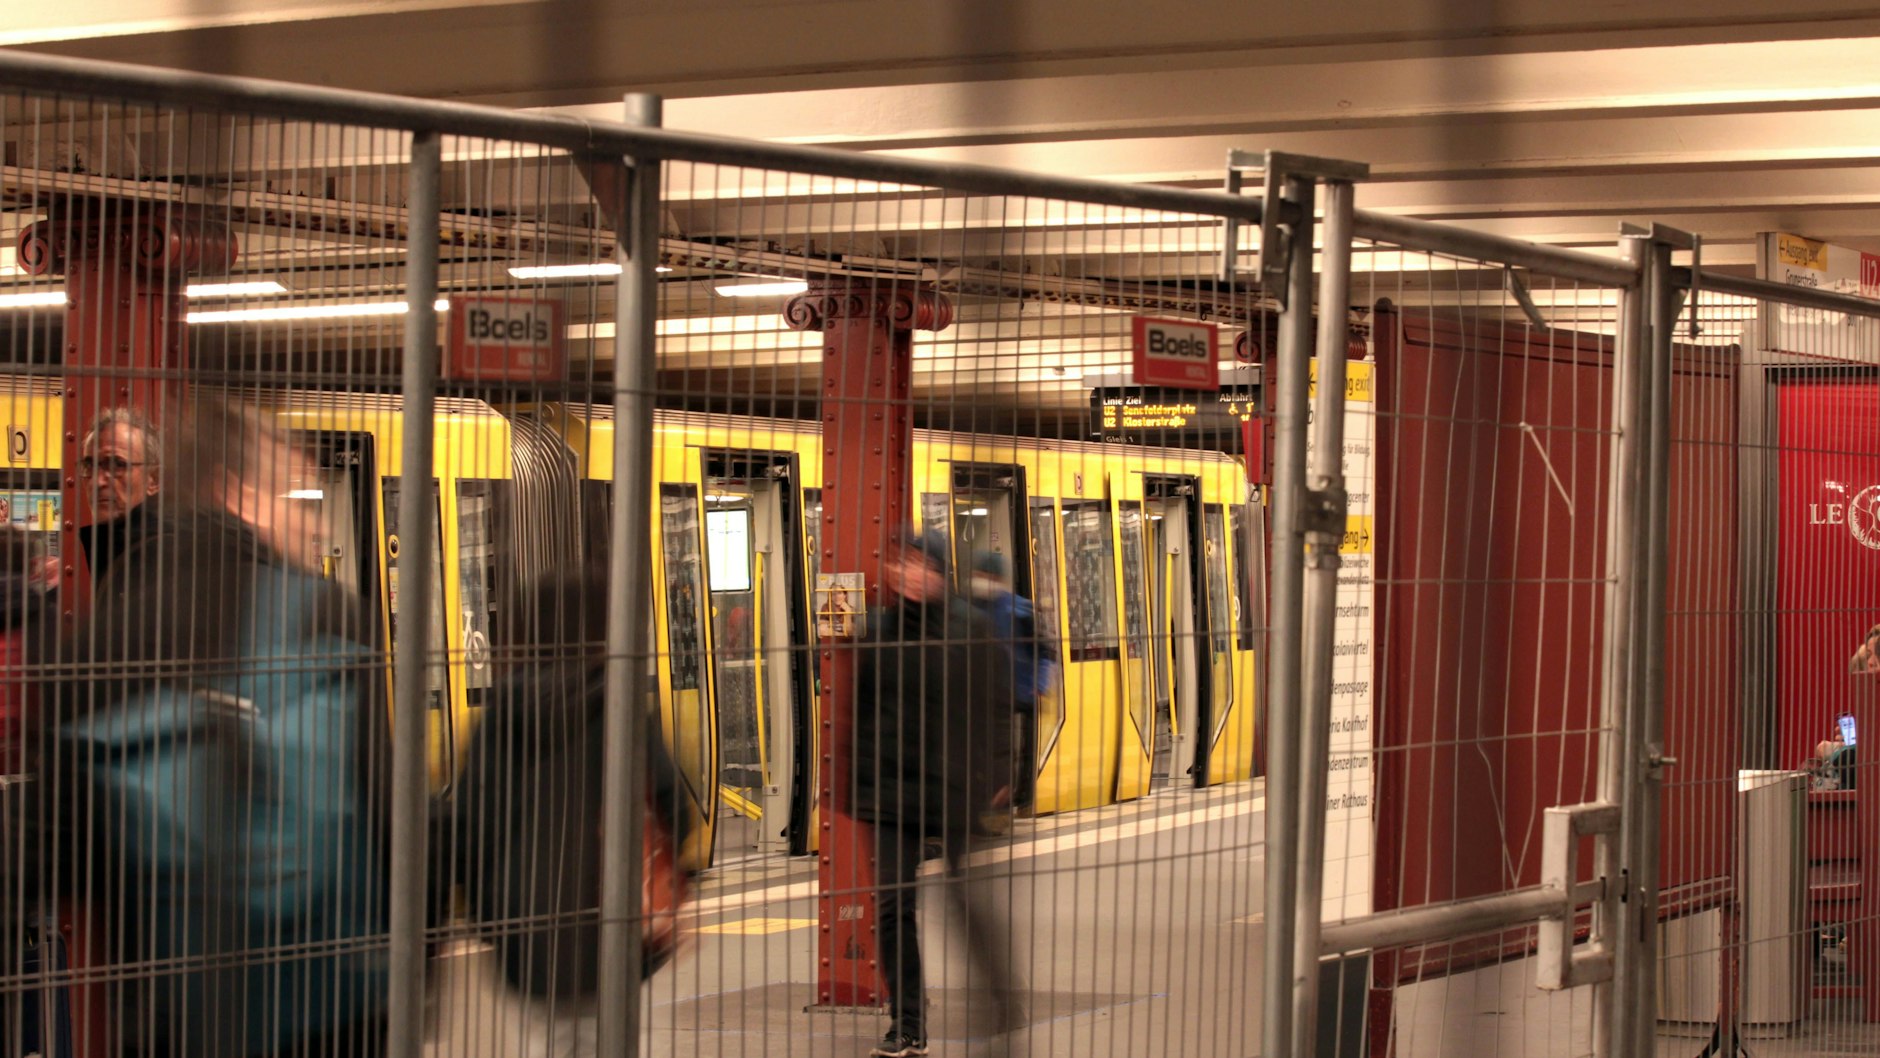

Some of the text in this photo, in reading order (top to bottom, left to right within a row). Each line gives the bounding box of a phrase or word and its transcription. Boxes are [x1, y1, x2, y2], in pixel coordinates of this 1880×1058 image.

[469, 309, 548, 341] Boels
[1149, 329, 1206, 358] Boels
[1125, 395, 1142, 405] Ziel
[1103, 405, 1116, 416] U2
[1103, 416, 1116, 428] U2
[1809, 503, 1844, 525] LE
